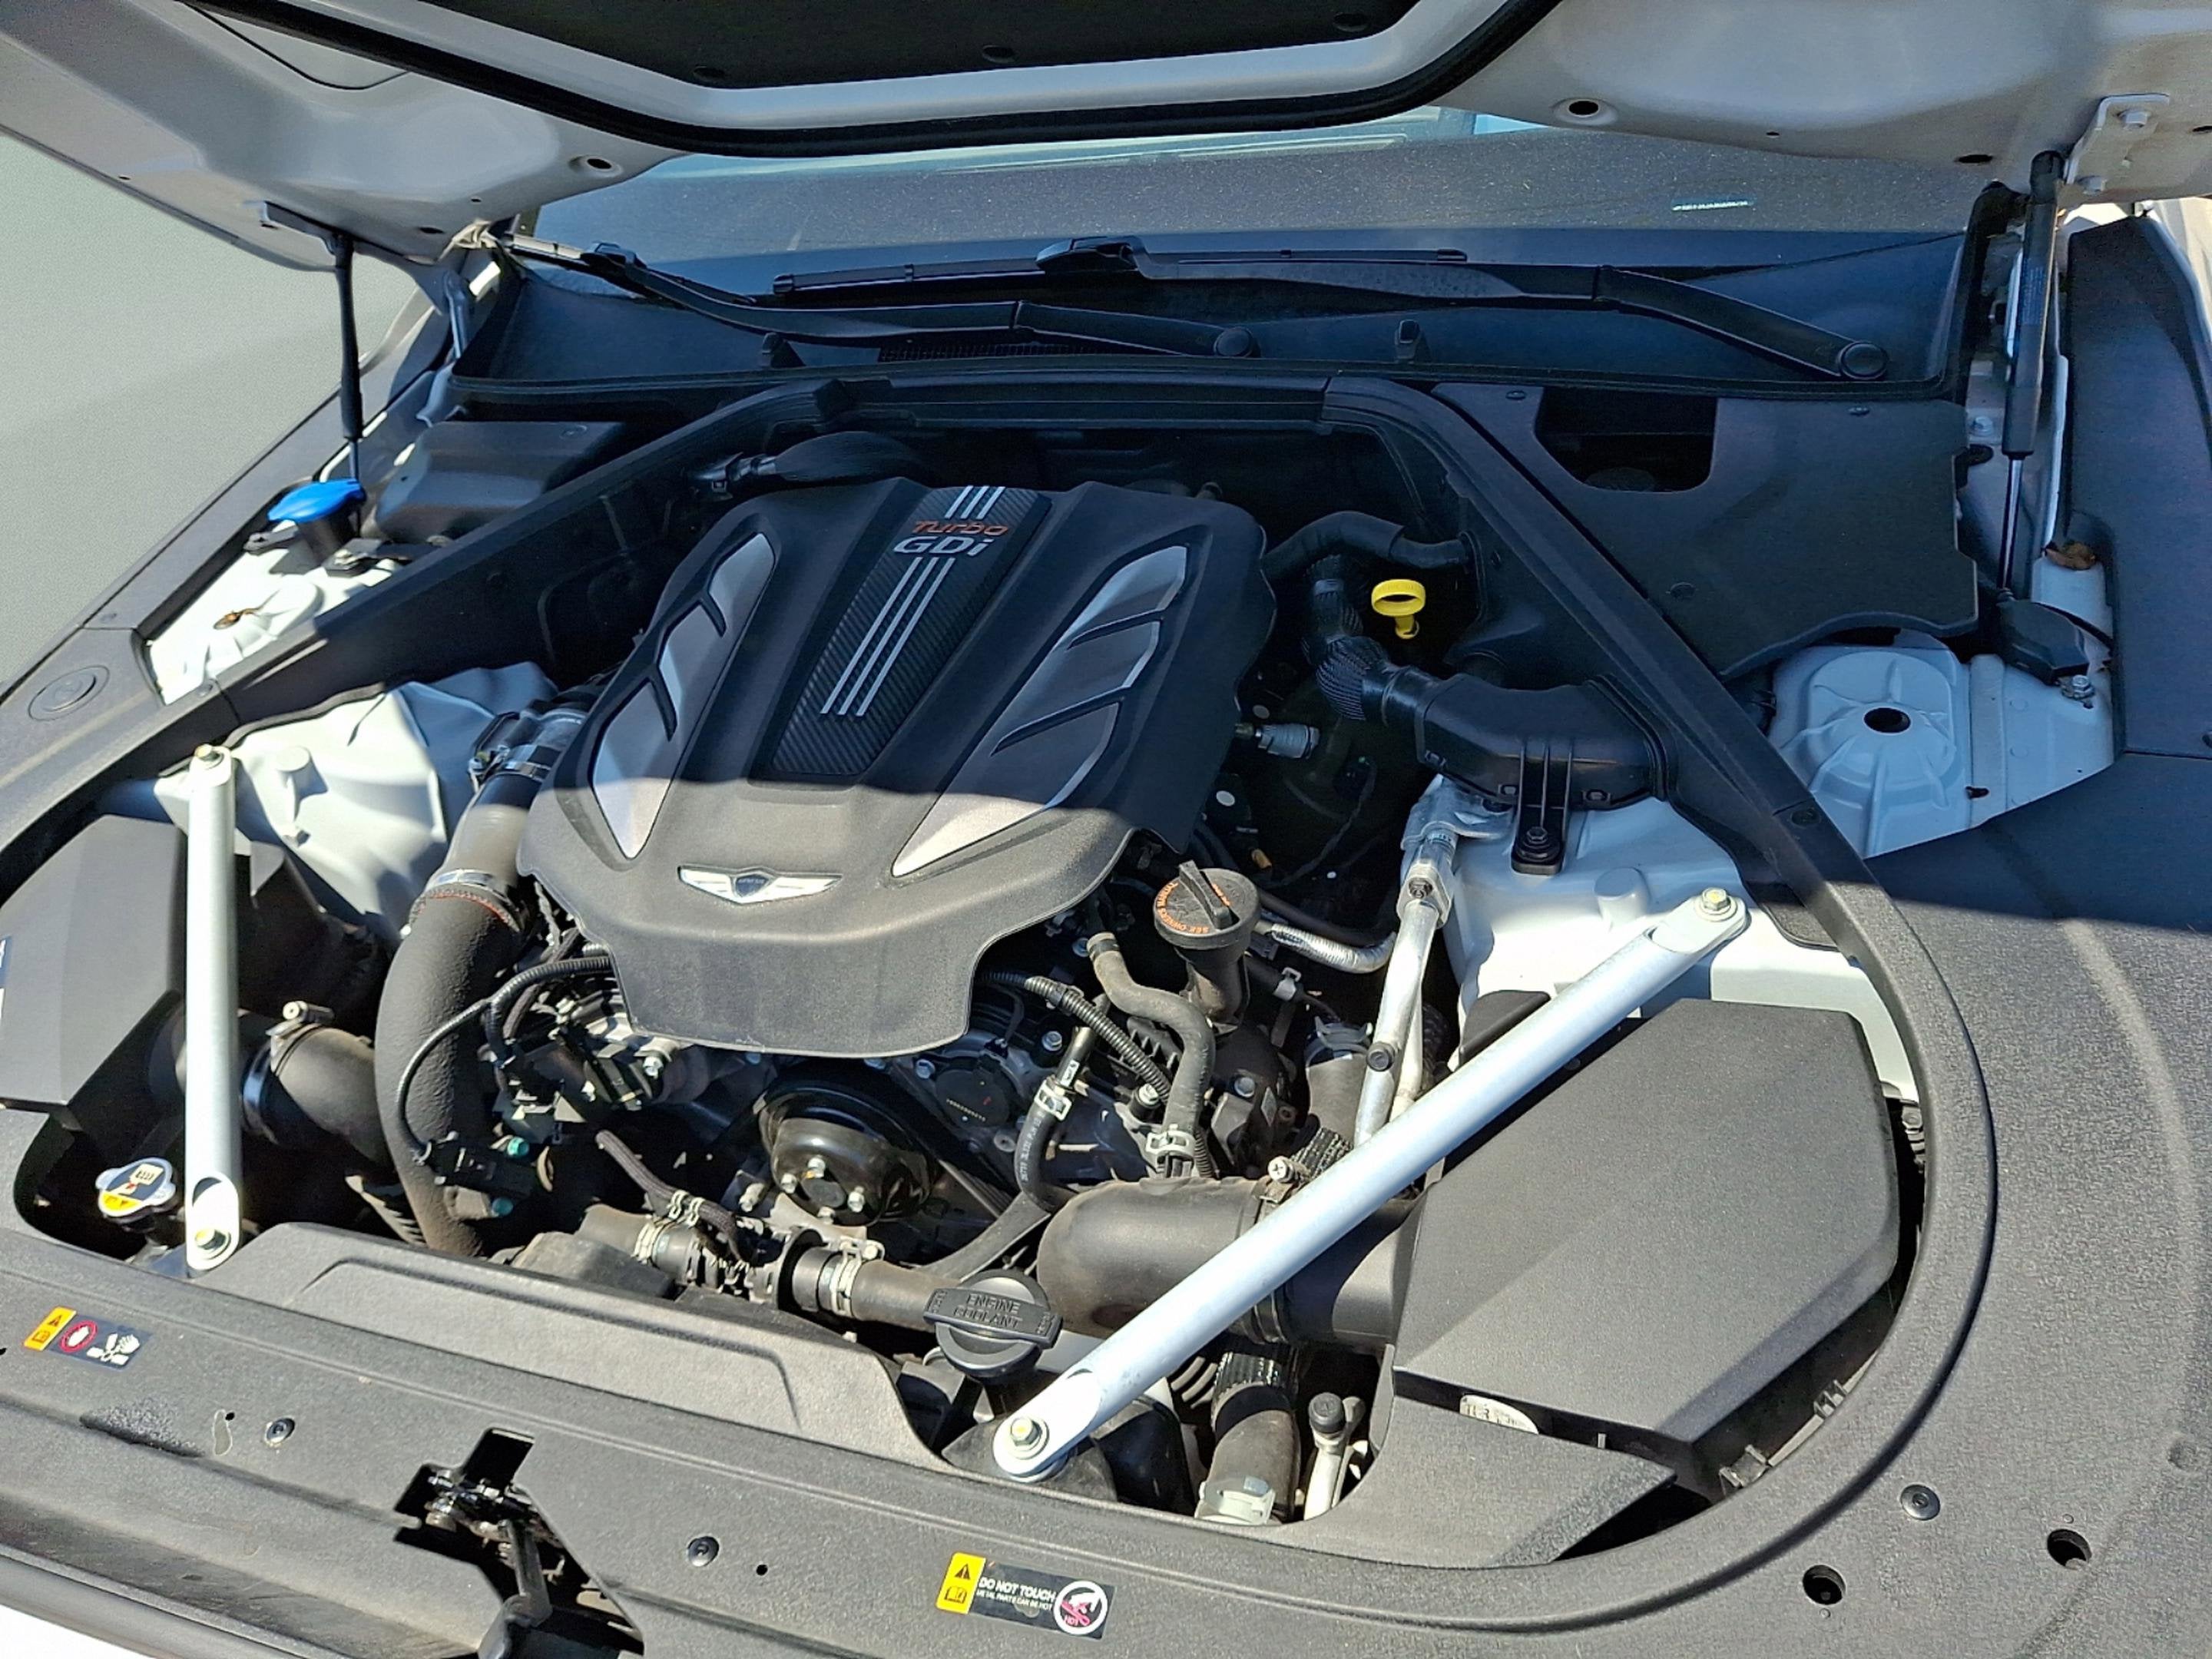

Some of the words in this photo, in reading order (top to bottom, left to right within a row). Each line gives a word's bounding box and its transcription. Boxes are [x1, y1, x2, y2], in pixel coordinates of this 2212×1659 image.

[893, 535, 995, 557] GDi
[966, 1293, 1022, 1315] ENGINE
[953, 1304, 1023, 1328] COOLANT
[979, 1577, 995, 1591] DO
[996, 1580, 1019, 1594] NOT
[1019, 1584, 1057, 1601] TOUCH
[1038, 1601, 1053, 1611] HOT
[1065, 1616, 1078, 1626] HOT
